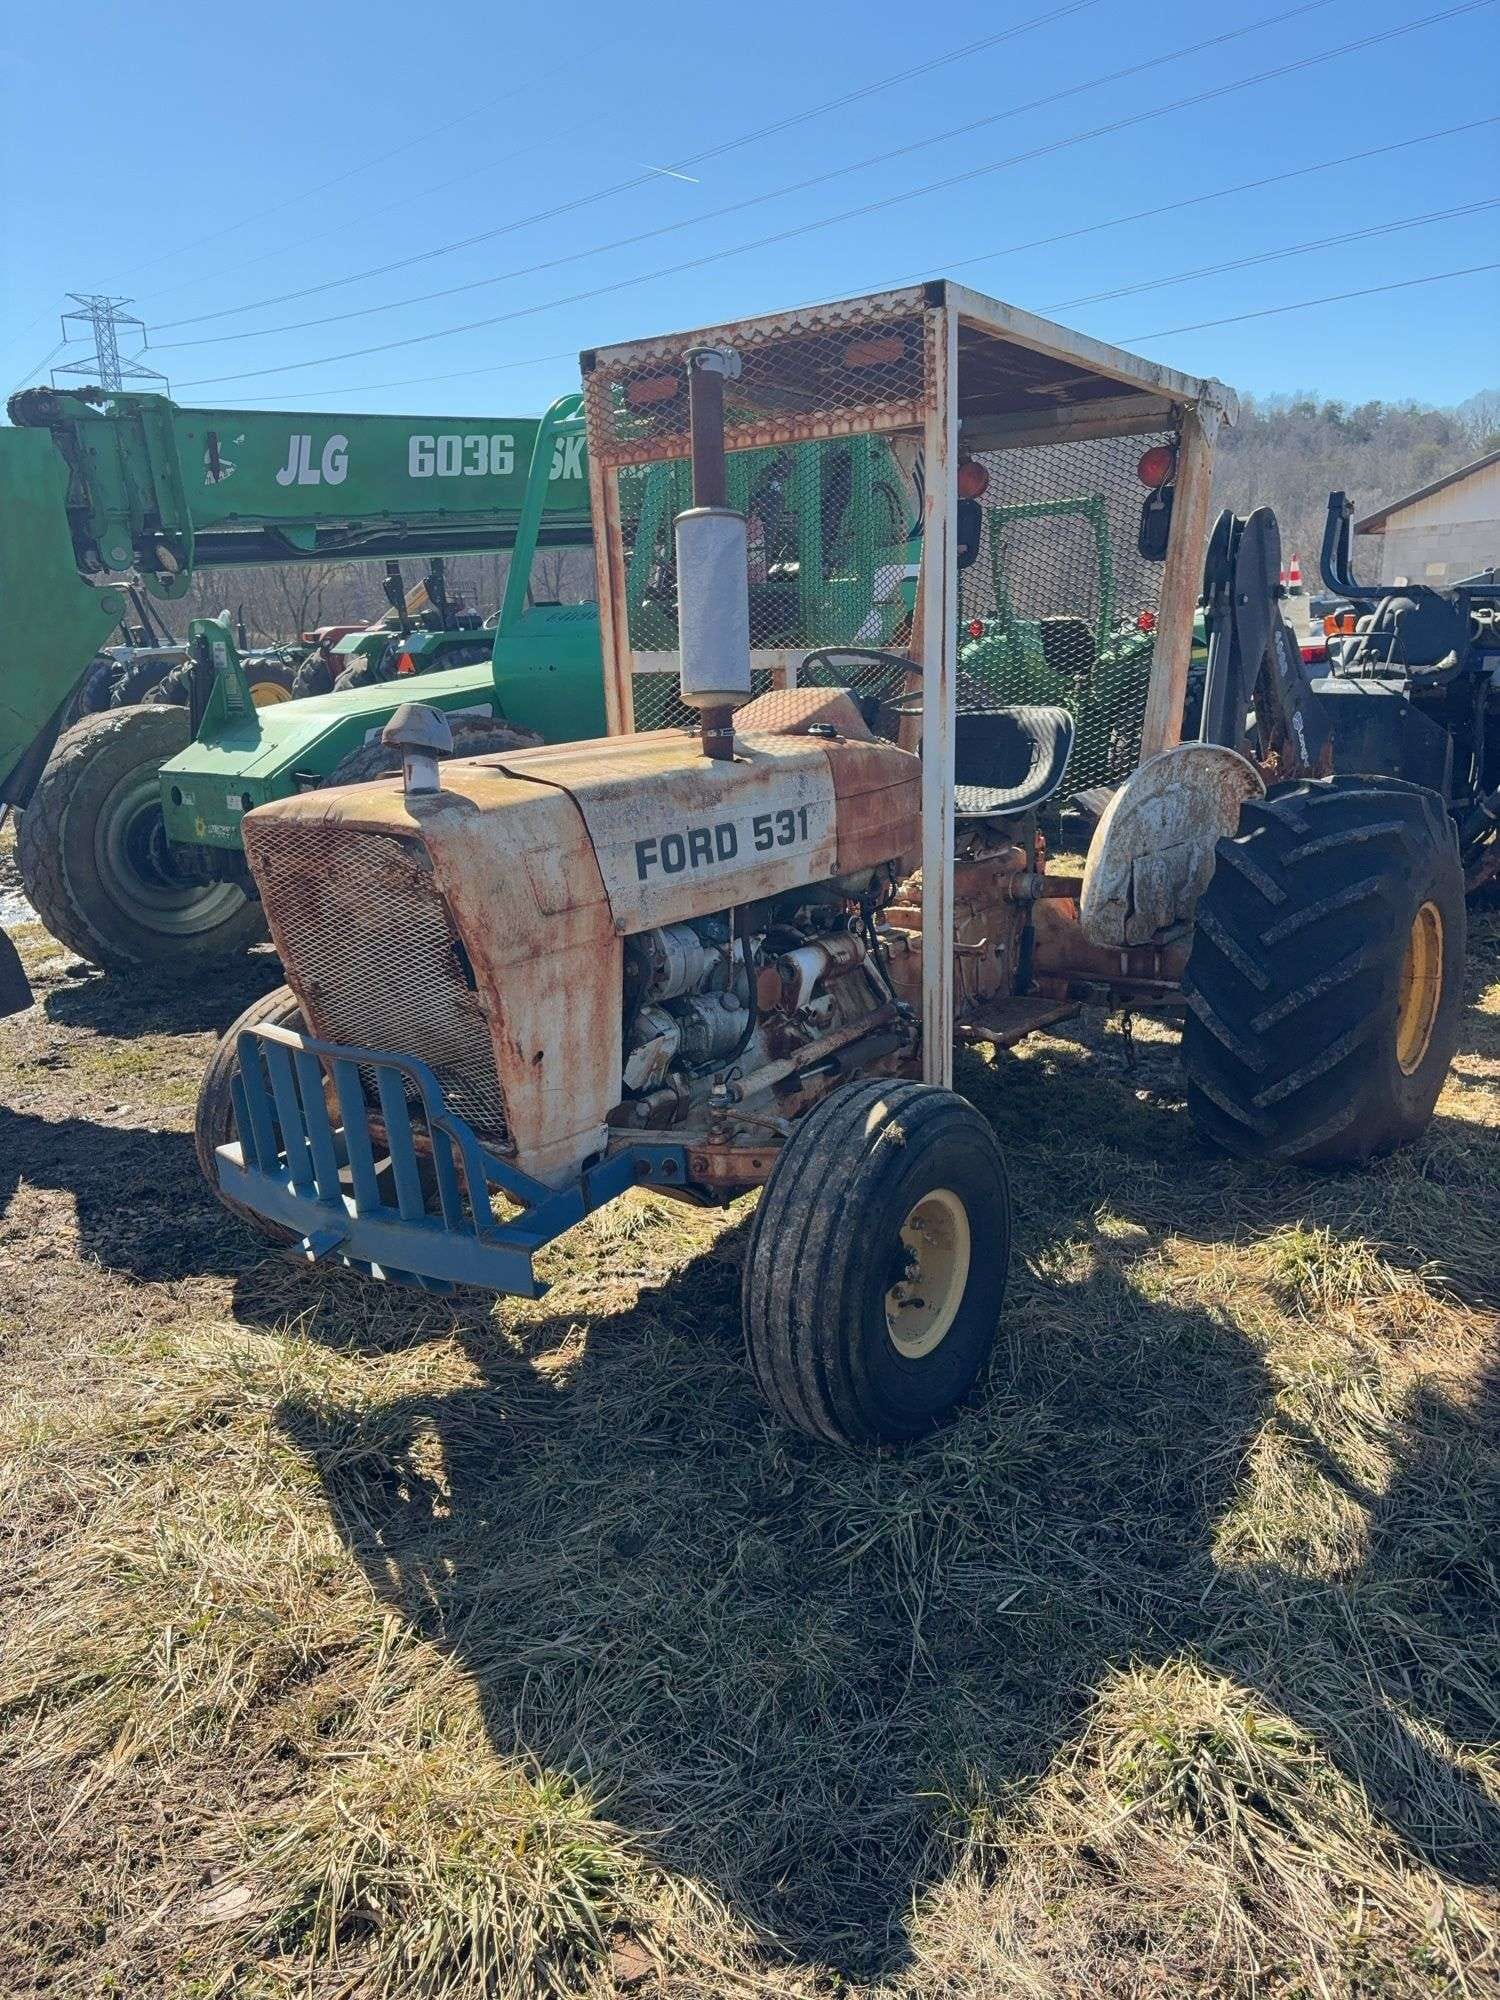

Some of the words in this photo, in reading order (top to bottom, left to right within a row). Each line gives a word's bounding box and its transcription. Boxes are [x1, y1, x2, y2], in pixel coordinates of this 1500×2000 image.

[276, 434, 349, 486] JLG
[408, 434, 514, 478] 6036
[635, 822, 738, 881] FORD
[752, 806, 809, 852] 531
